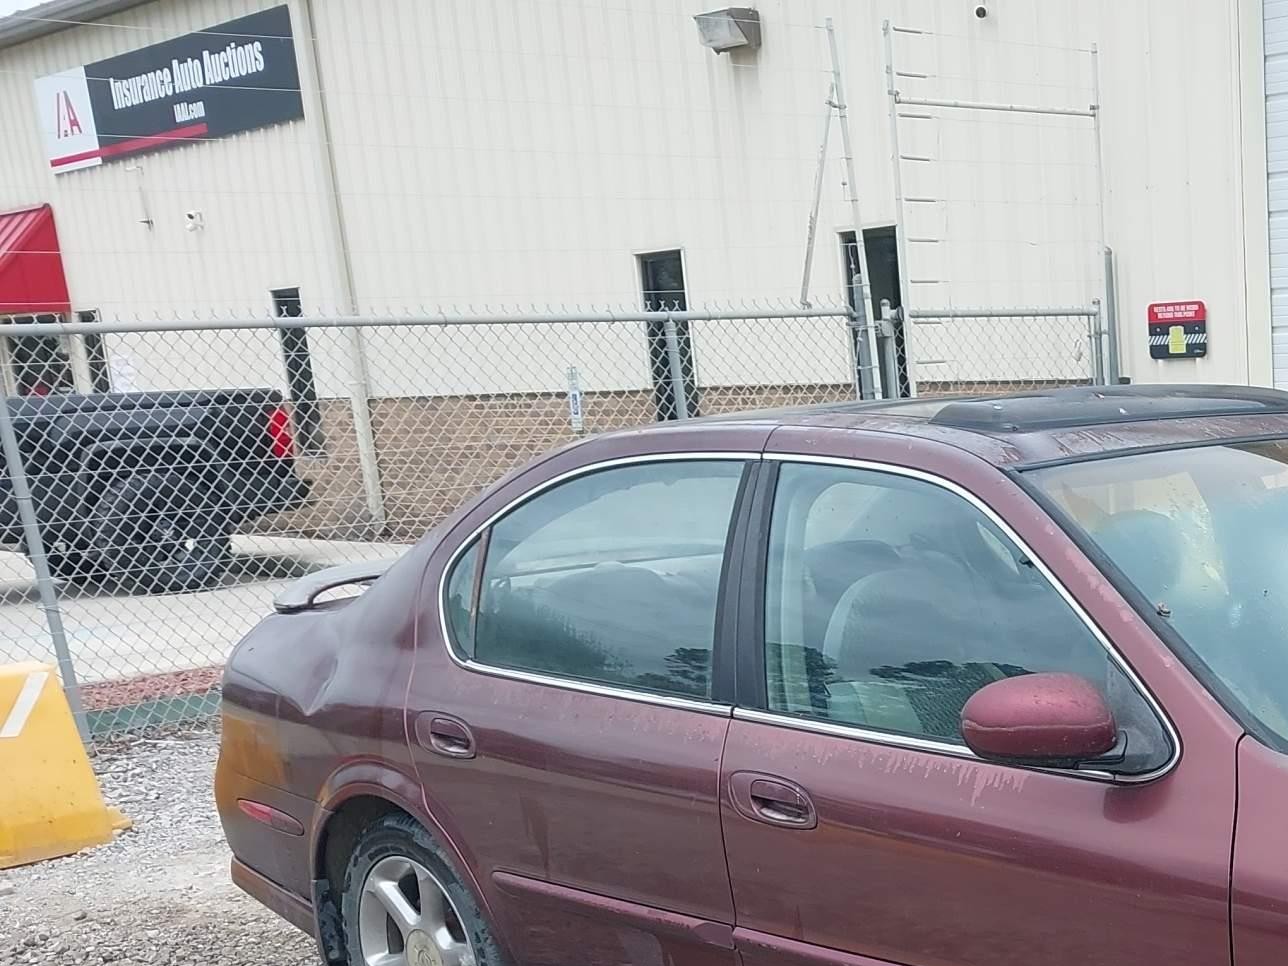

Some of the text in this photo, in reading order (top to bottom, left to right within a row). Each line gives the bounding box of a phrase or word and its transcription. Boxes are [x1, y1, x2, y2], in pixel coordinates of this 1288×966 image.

[109, 41, 265, 110] Insurance Auto Auctions
